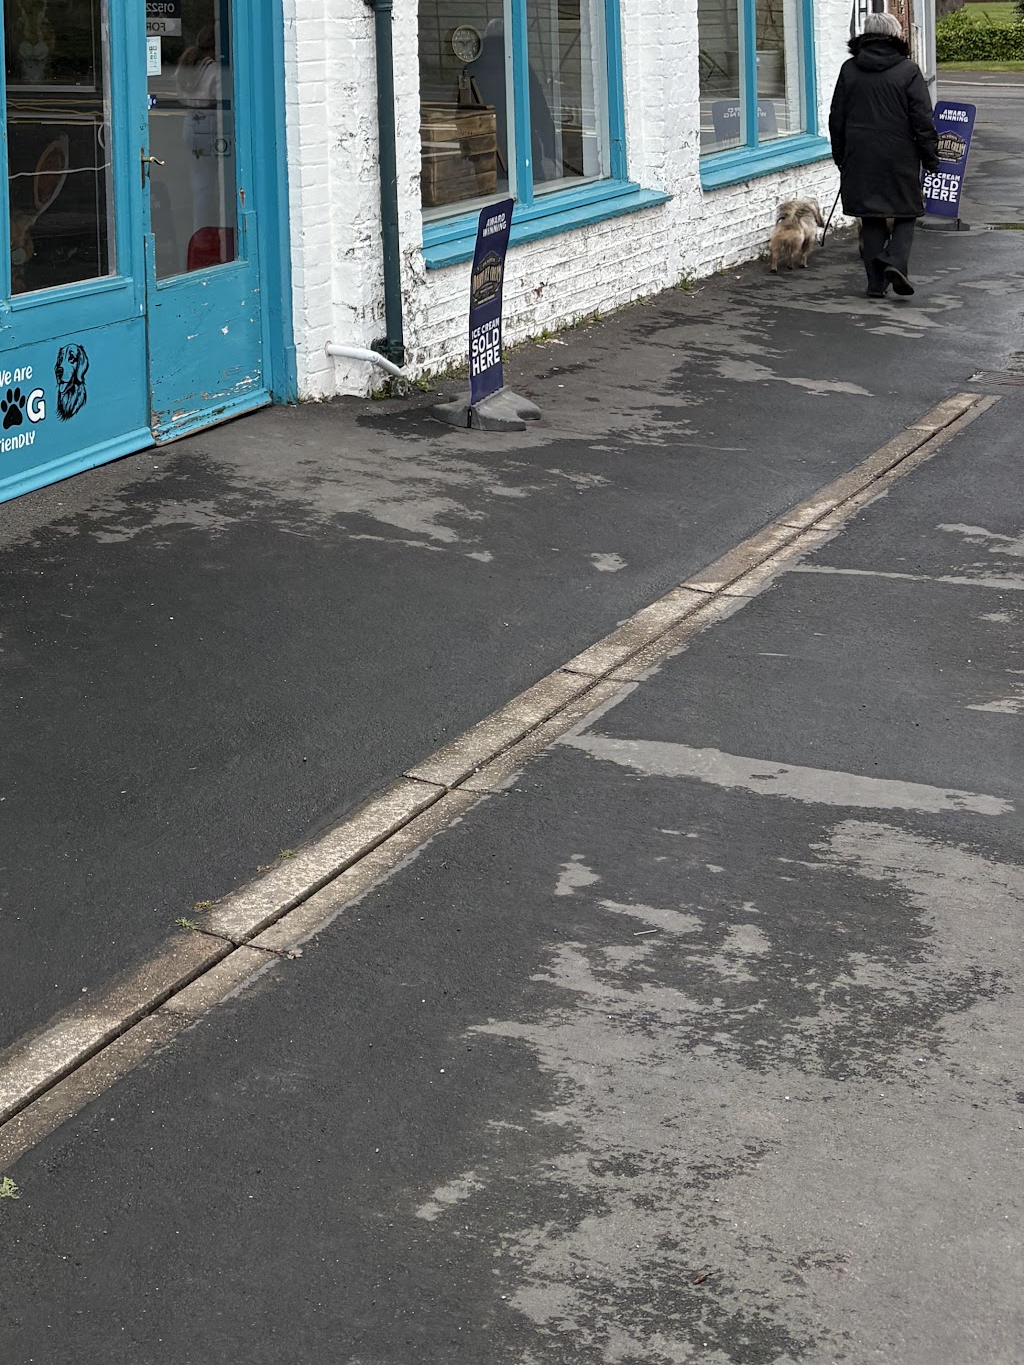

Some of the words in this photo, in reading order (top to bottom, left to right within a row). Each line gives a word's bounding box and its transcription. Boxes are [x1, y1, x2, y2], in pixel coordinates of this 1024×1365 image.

[939, 114, 969, 123] WINNING
[943, 109, 966, 117] AWARD
[924, 177, 959, 191] SOLD
[937, 172, 961, 181] CREAM
[923, 187, 958, 203] HERE
[486, 213, 506, 227] AWARD
[471, 327, 481, 340] ICE
[481, 317, 500, 334] CREAM
[472, 328, 500, 357] SOLD
[472, 345, 501, 377] HERE
[13, 365, 33, 382] Are
